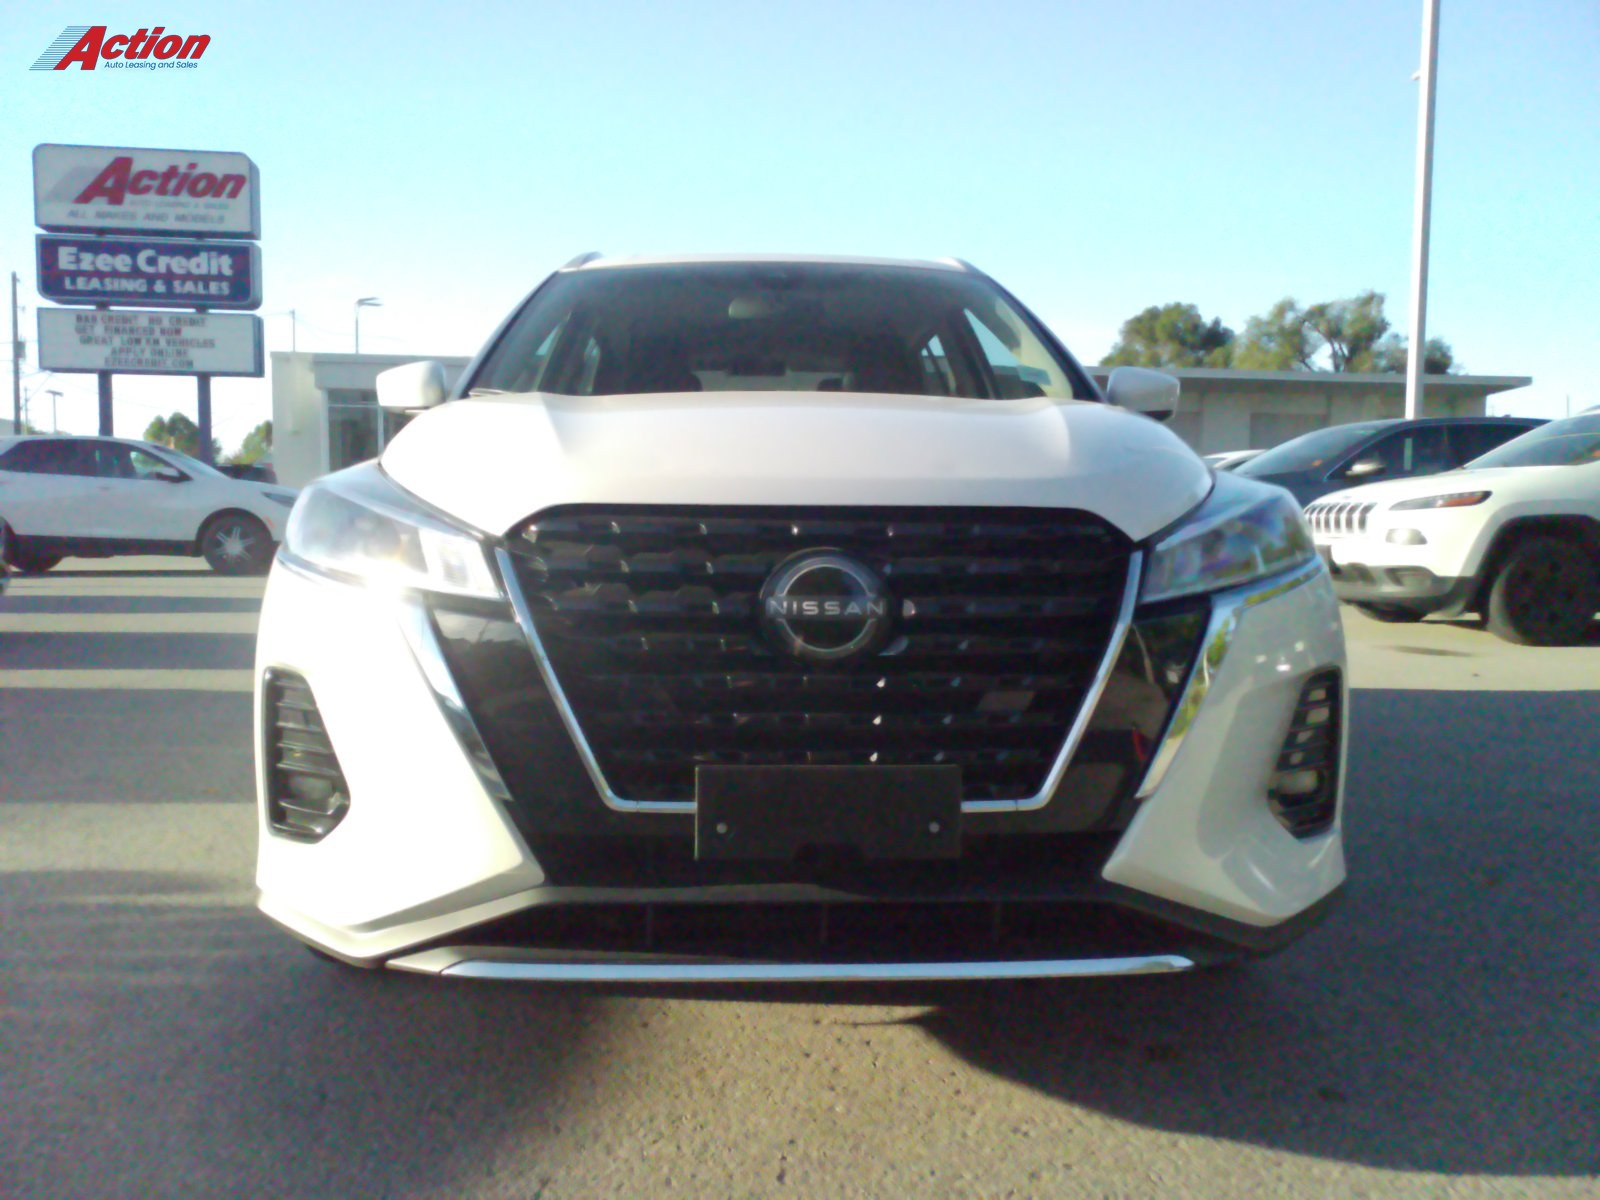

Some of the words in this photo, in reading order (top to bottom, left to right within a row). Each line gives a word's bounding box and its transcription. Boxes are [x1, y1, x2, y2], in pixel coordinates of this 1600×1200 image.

[72, 157, 247, 206] Action
[67, 209, 87, 218] ALL
[95, 210, 137, 220] MAKES
[144, 212, 169, 222] AND
[174, 213, 225, 224] MODELS
[57, 246, 132, 272] Ezee
[137, 249, 233, 276] Credit
[64, 277, 147, 293] LEASING
[153, 279, 167, 293] &
[172, 280, 230, 295] SALES
[76, 314, 98, 324] BAD
[101, 314, 138, 325] CREDIT
[169, 316, 207, 326] CREDIT
[75, 325, 95, 335] GET
[104, 326, 155, 336] FINANCED
[160, 327, 182, 336] NOW
[79, 335, 114, 345] GREAT
[120, 336, 142, 346] LOW
[165, 338, 216, 348] VEHICLES
[110, 347, 146, 357] APPLY
[150, 348, 189, 358] ONLINE
[769, 600, 884, 615] NISSAN
